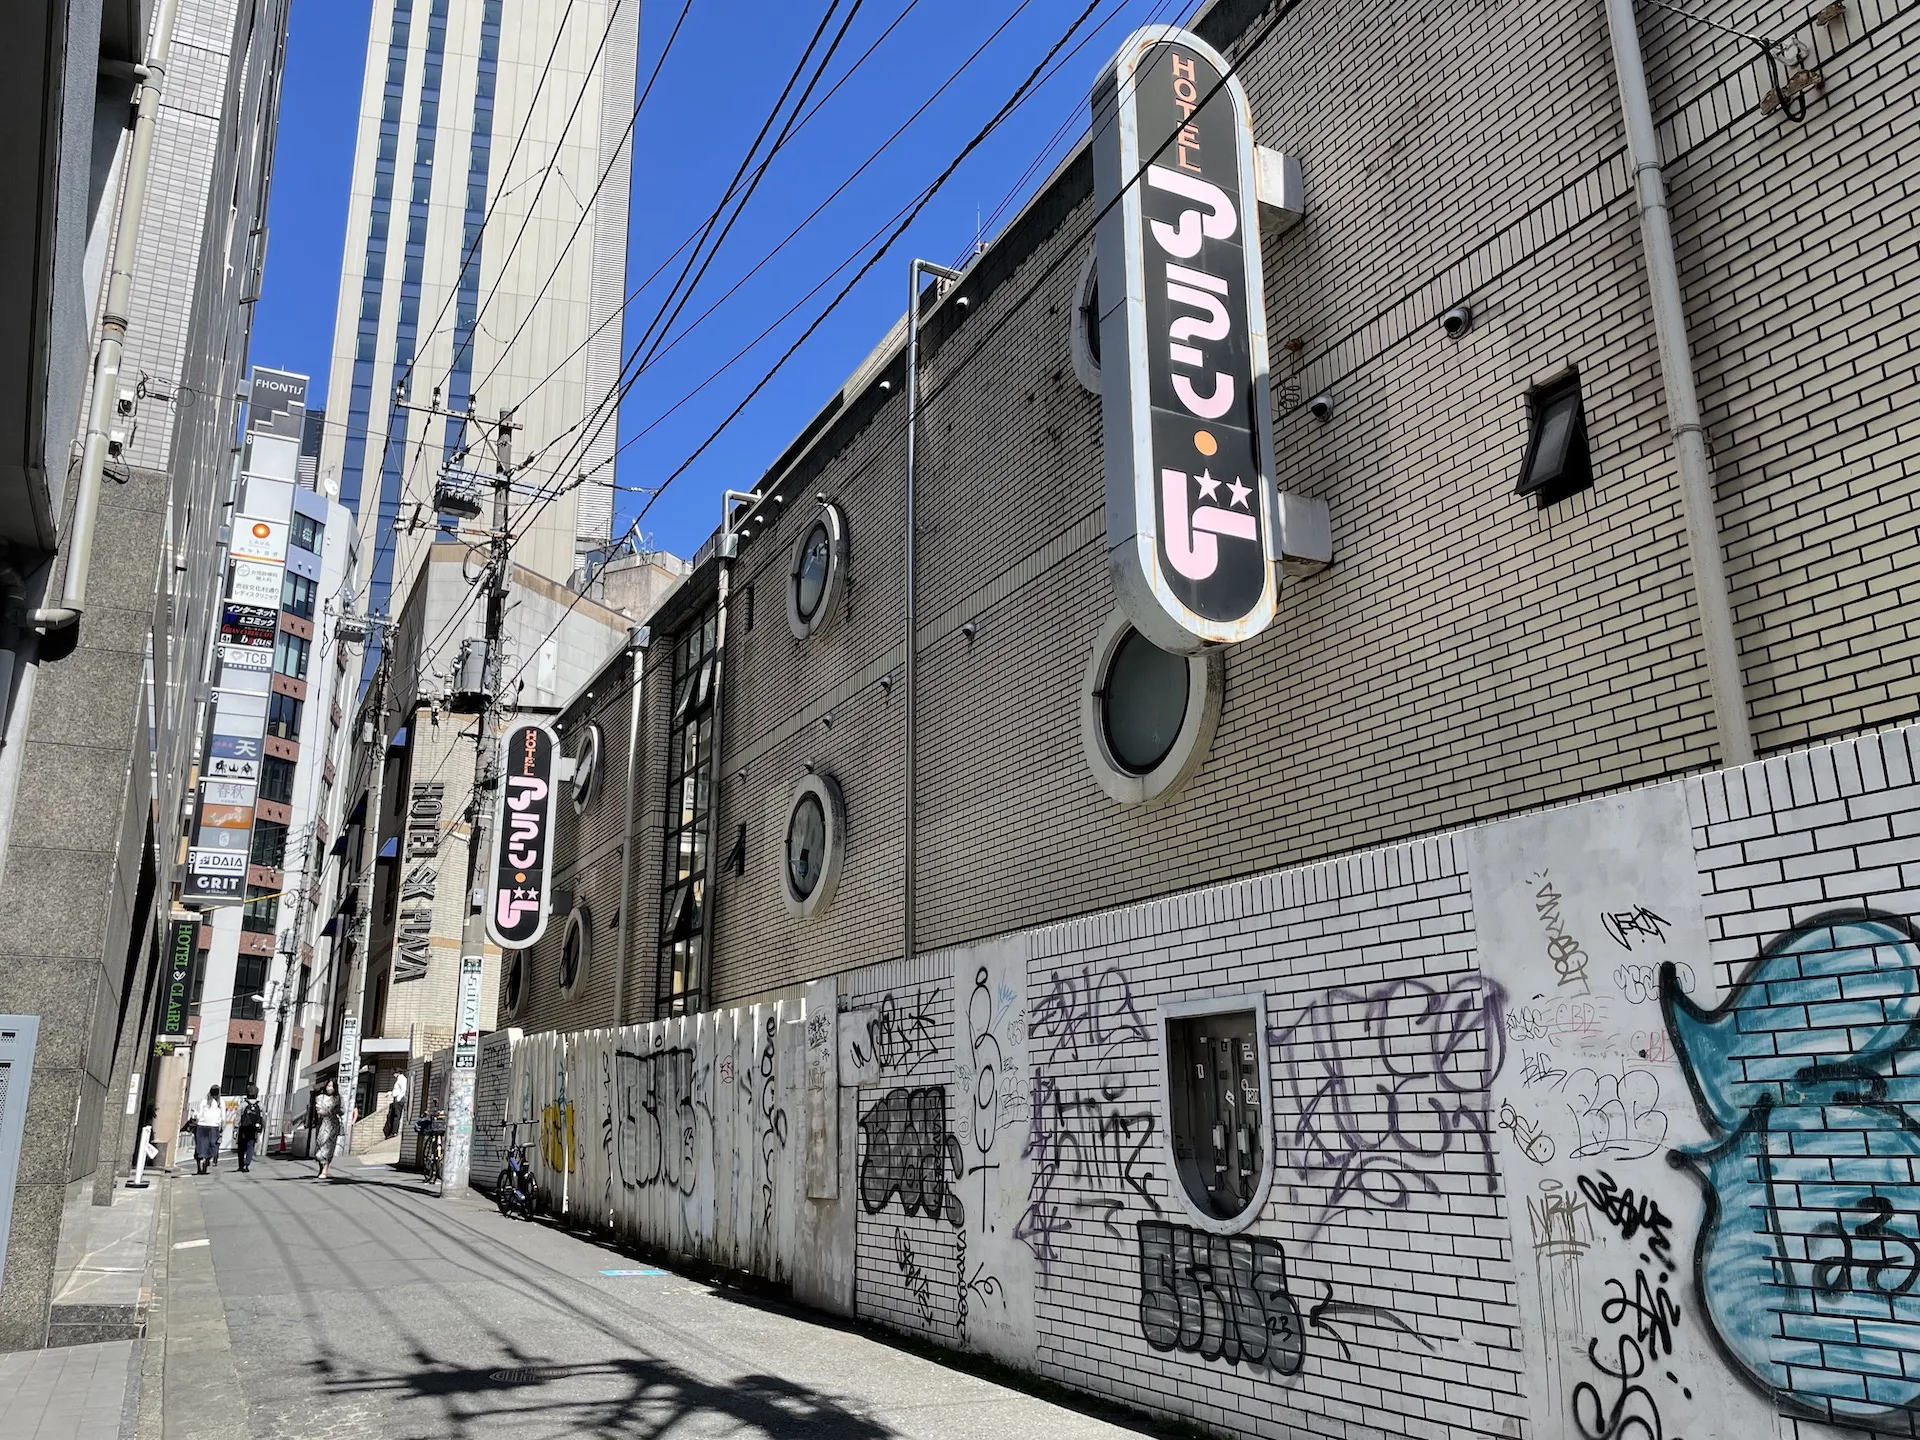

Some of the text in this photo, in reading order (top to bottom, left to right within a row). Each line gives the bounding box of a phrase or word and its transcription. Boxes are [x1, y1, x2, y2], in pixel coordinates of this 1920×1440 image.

[1171, 52, 1202, 173] HOTEL
[255, 378, 304, 395] FHONTIS
[246, 435, 253, 445] 8
[241, 475, 249, 486] 7
[227, 604, 276, 618] インターネット
[217, 647, 225, 659] 3
[244, 651, 268, 665] TCB
[211, 692, 219, 703] 2
[234, 739, 257, 757] 天
[523, 729, 537, 776] HOTEL
[200, 782, 206, 793] 1
[217, 783, 245, 800] 春秋
[212, 856, 243, 867] DAIA
[197, 876, 239, 890] GRIT
[173, 924, 193, 970] HOTEL
